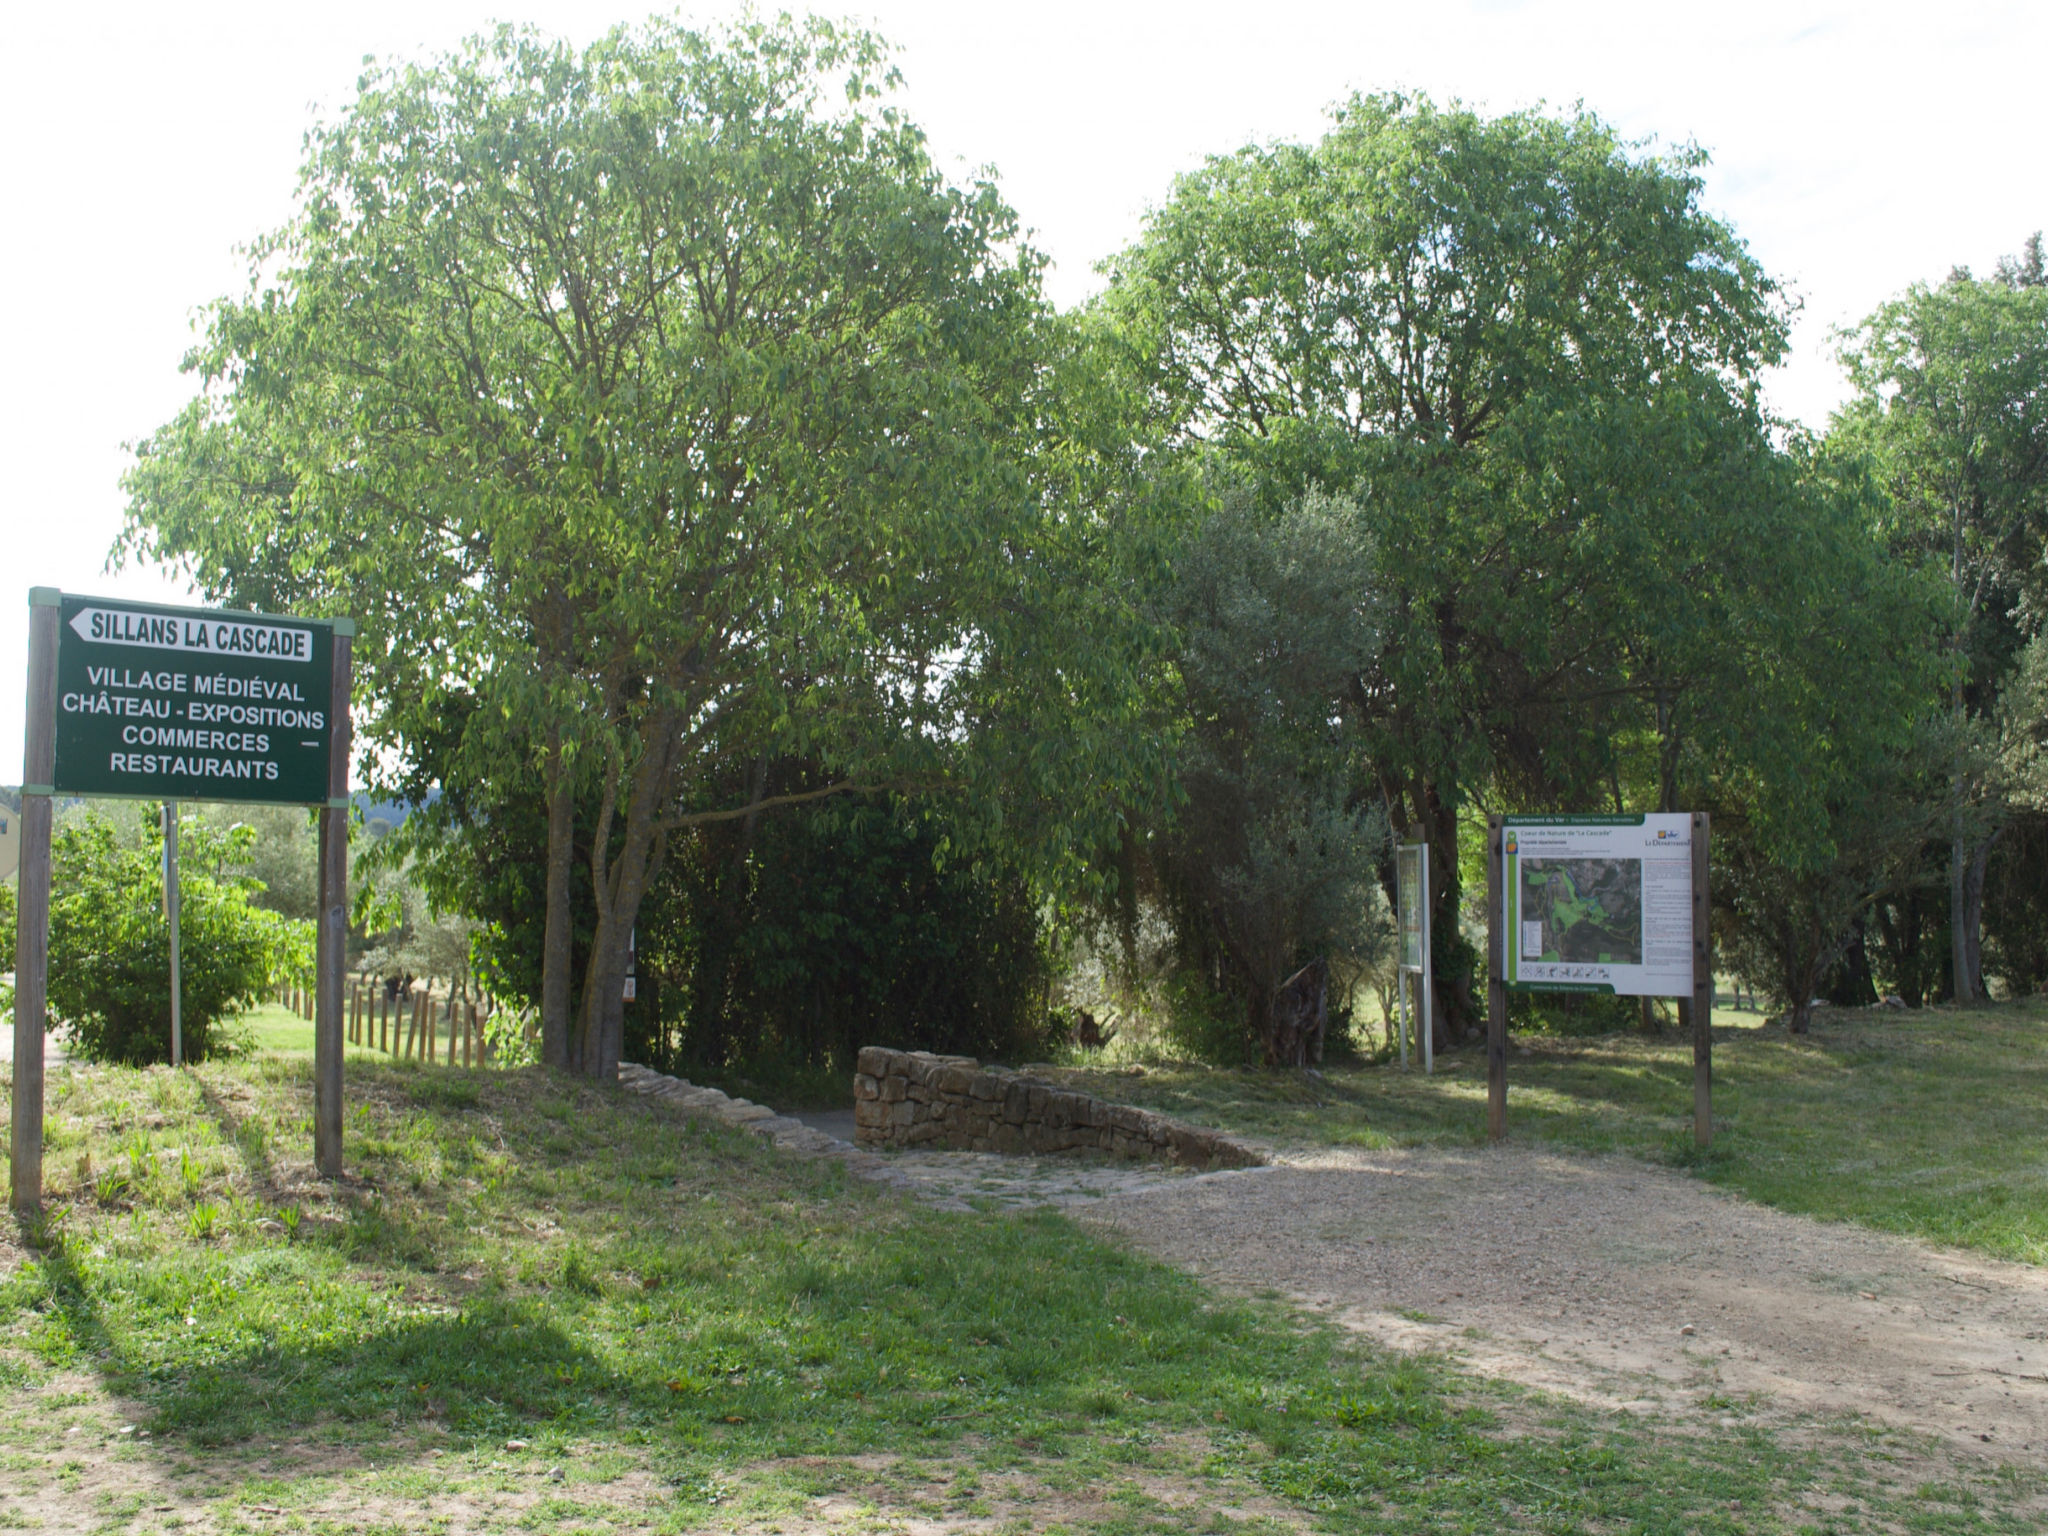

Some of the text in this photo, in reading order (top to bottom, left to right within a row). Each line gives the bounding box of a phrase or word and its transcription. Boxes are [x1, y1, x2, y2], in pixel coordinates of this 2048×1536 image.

[91, 611, 305, 657] SILLANS LA CASCADE
[87, 666, 305, 701] VILLAGE MÉDIÉVAL
[63, 691, 171, 718] CHÂTEAU
[188, 703, 325, 730] EXPOSITIONS
[122, 726, 269, 752] COMMERCES
[110, 753, 279, 780] RESTAURANTS
